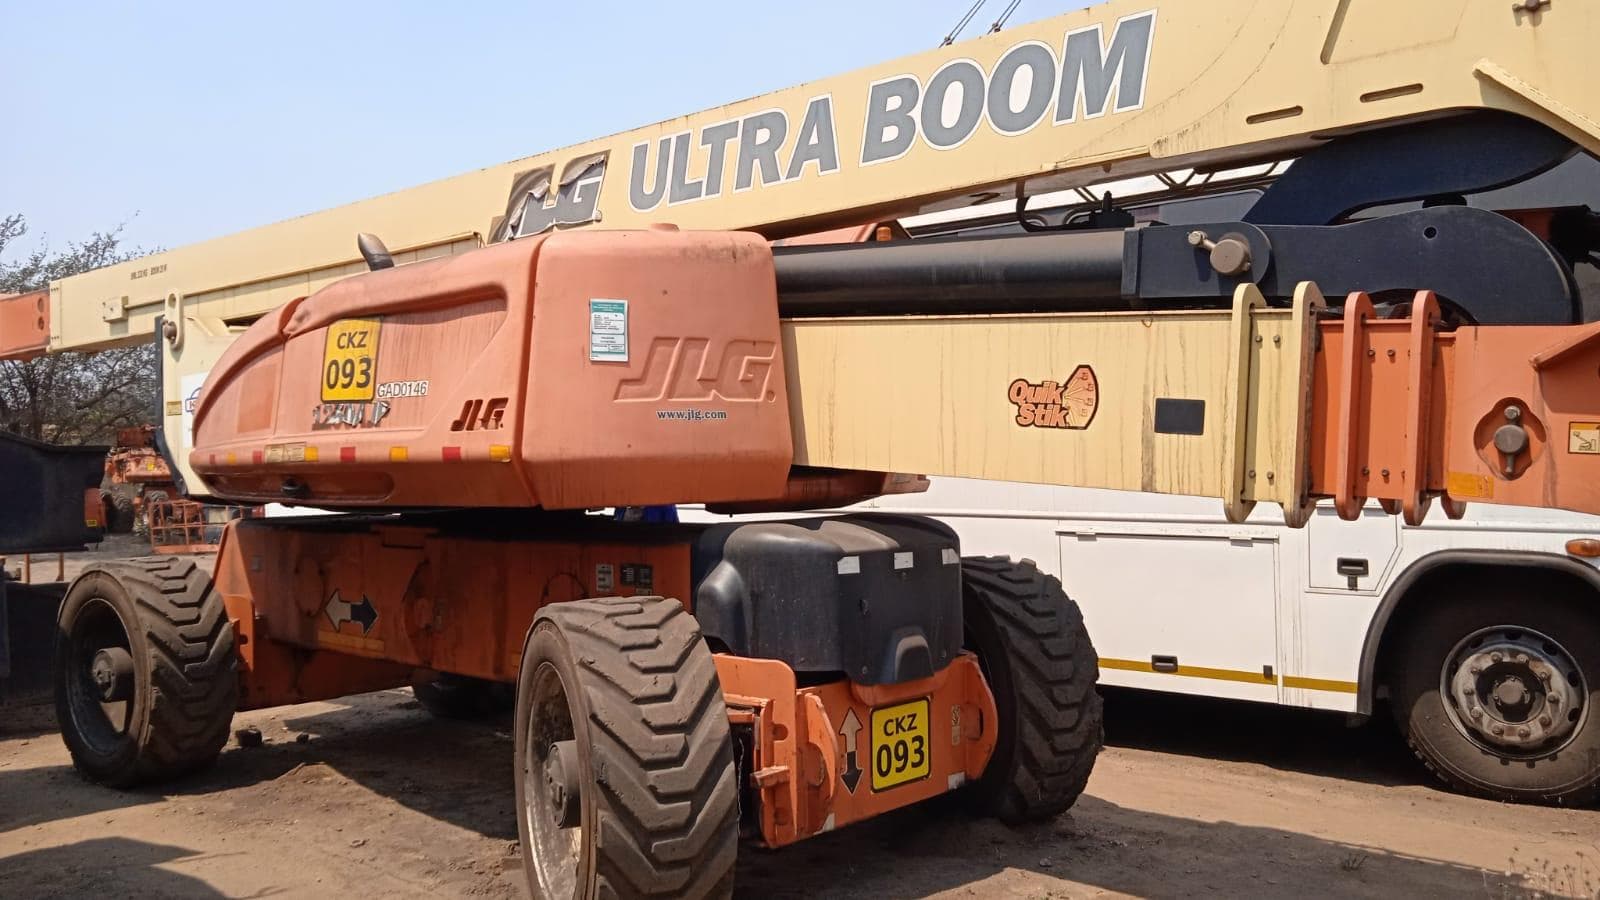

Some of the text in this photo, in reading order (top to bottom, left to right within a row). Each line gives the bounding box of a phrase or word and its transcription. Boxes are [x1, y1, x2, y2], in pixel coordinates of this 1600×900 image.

[627, 92, 840, 213] ULTRA
[859, 9, 1157, 168] BOOM
[337, 331, 368, 350] CKZ
[326, 357, 373, 390] 093
[377, 381, 428, 398] GAD0146
[1008, 378, 1068, 405] Quik
[657, 409, 727, 421] www.jlg.com
[1015, 403, 1069, 428] Stik
[883, 713, 918, 737] CKZ
[876, 735, 925, 778] 093
